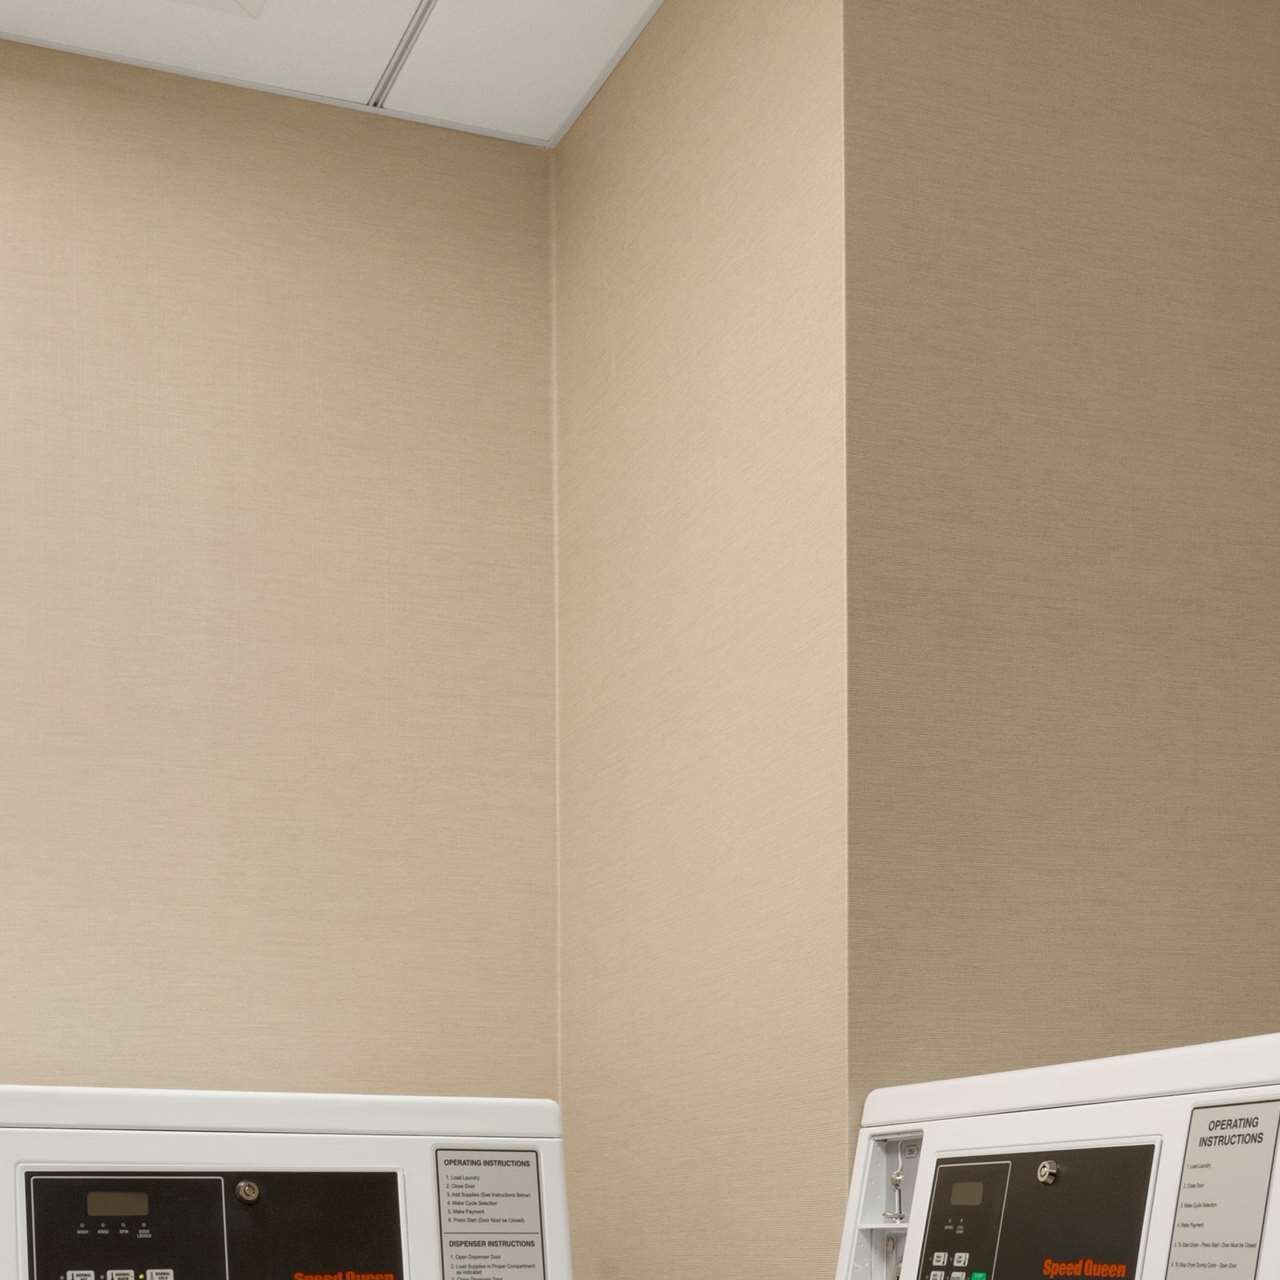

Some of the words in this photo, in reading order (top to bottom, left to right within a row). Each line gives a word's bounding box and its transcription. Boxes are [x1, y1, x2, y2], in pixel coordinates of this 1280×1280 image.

[1208, 1117, 1259, 1131] OPERATING
[1199, 1133, 1263, 1147] INSTRUCTIONS
[1043, 1259, 1084, 1279] Speed
[1084, 1259, 1126, 1277] Queen
